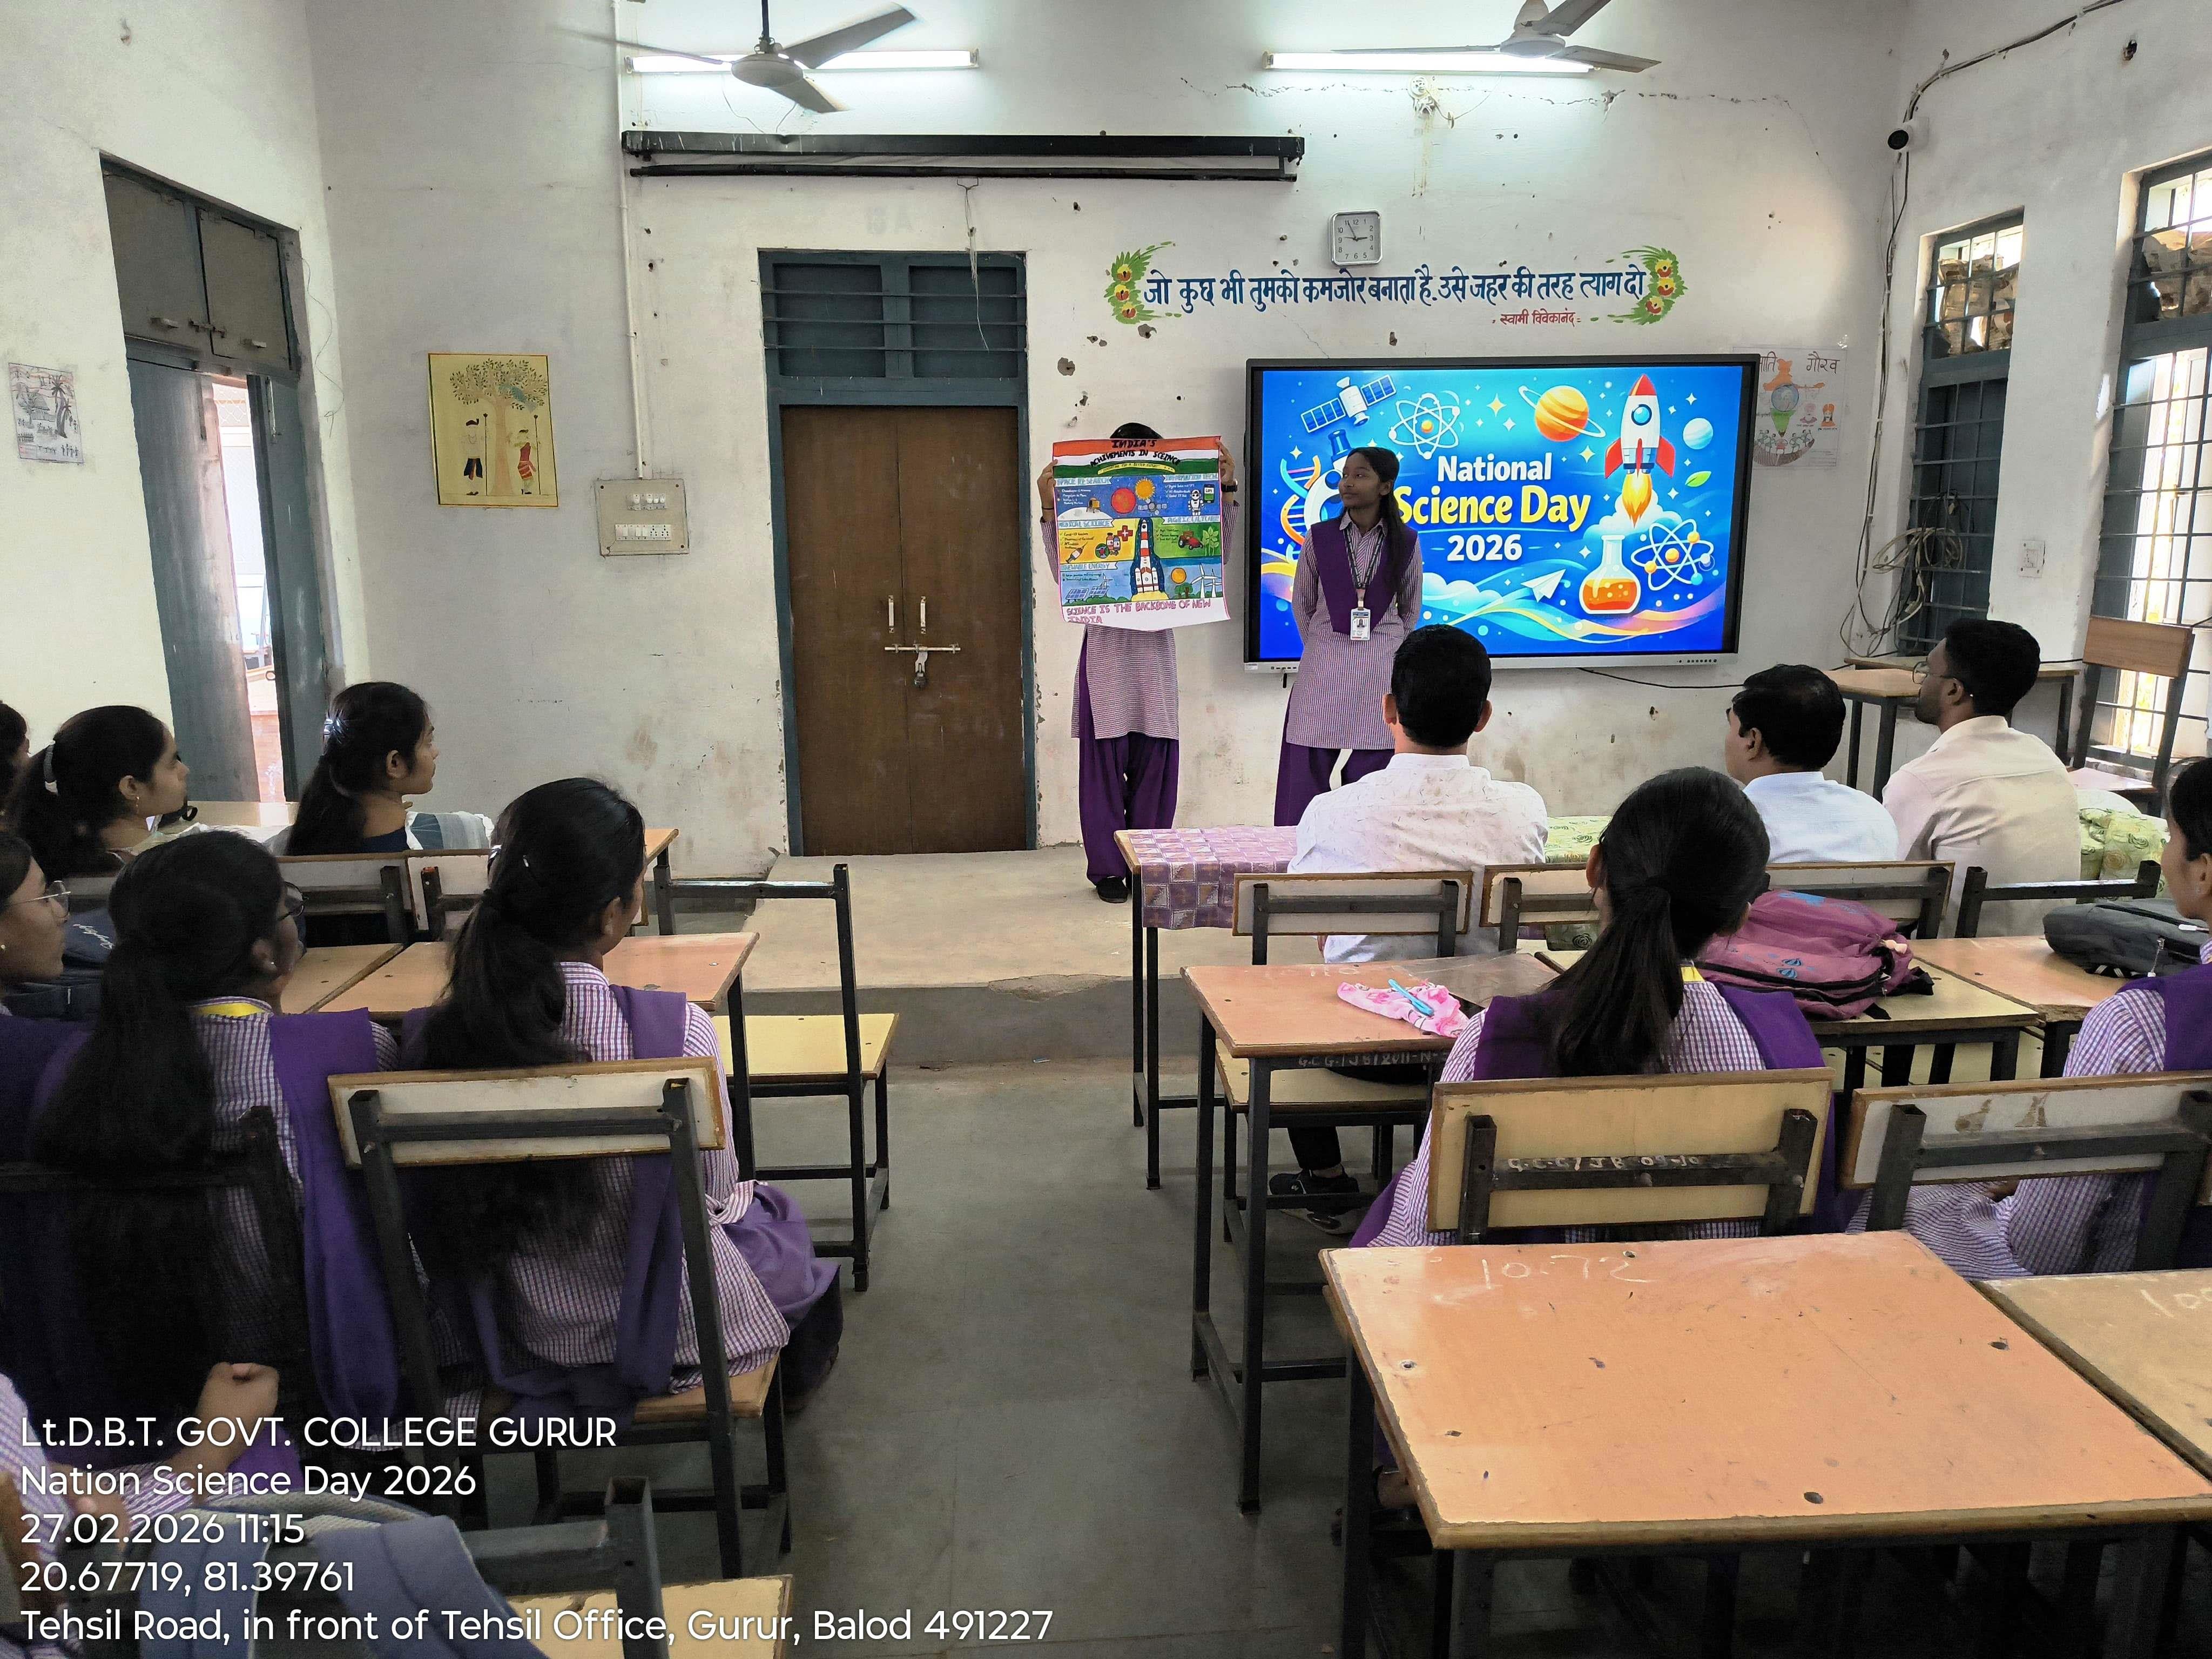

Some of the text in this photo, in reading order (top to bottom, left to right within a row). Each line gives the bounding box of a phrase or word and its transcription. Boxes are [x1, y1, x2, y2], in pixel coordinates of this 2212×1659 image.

[1144, 269, 1172, 305] जो
[1220, 269, 1246, 304] भी
[1249, 269, 1300, 312] तुमको
[1303, 268, 1367, 304] कमजोर
[1368, 276, 1417, 305] बनाता
[1438, 266, 1469, 303] उसे
[1470, 274, 1512, 306] जहर
[1512, 266, 1536, 299] की
[1537, 273, 1576, 300] तरह
[1579, 272, 1623, 298] त्याग
[1624, 264, 1647, 300] दो
[1500, 307, 1576, 327] स्वामी विवेकानंद
[1806, 351, 1840, 375] गौरव
[1111, 439, 1157, 449] INDIA'S
[1438, 452, 1552, 482] National
[1394, 484, 1591, 532] Science Day
[1447, 534, 1523, 562] 2026
[1067, 598, 1211, 616] SCIENCE IS THE BACKBONE OF NEW
